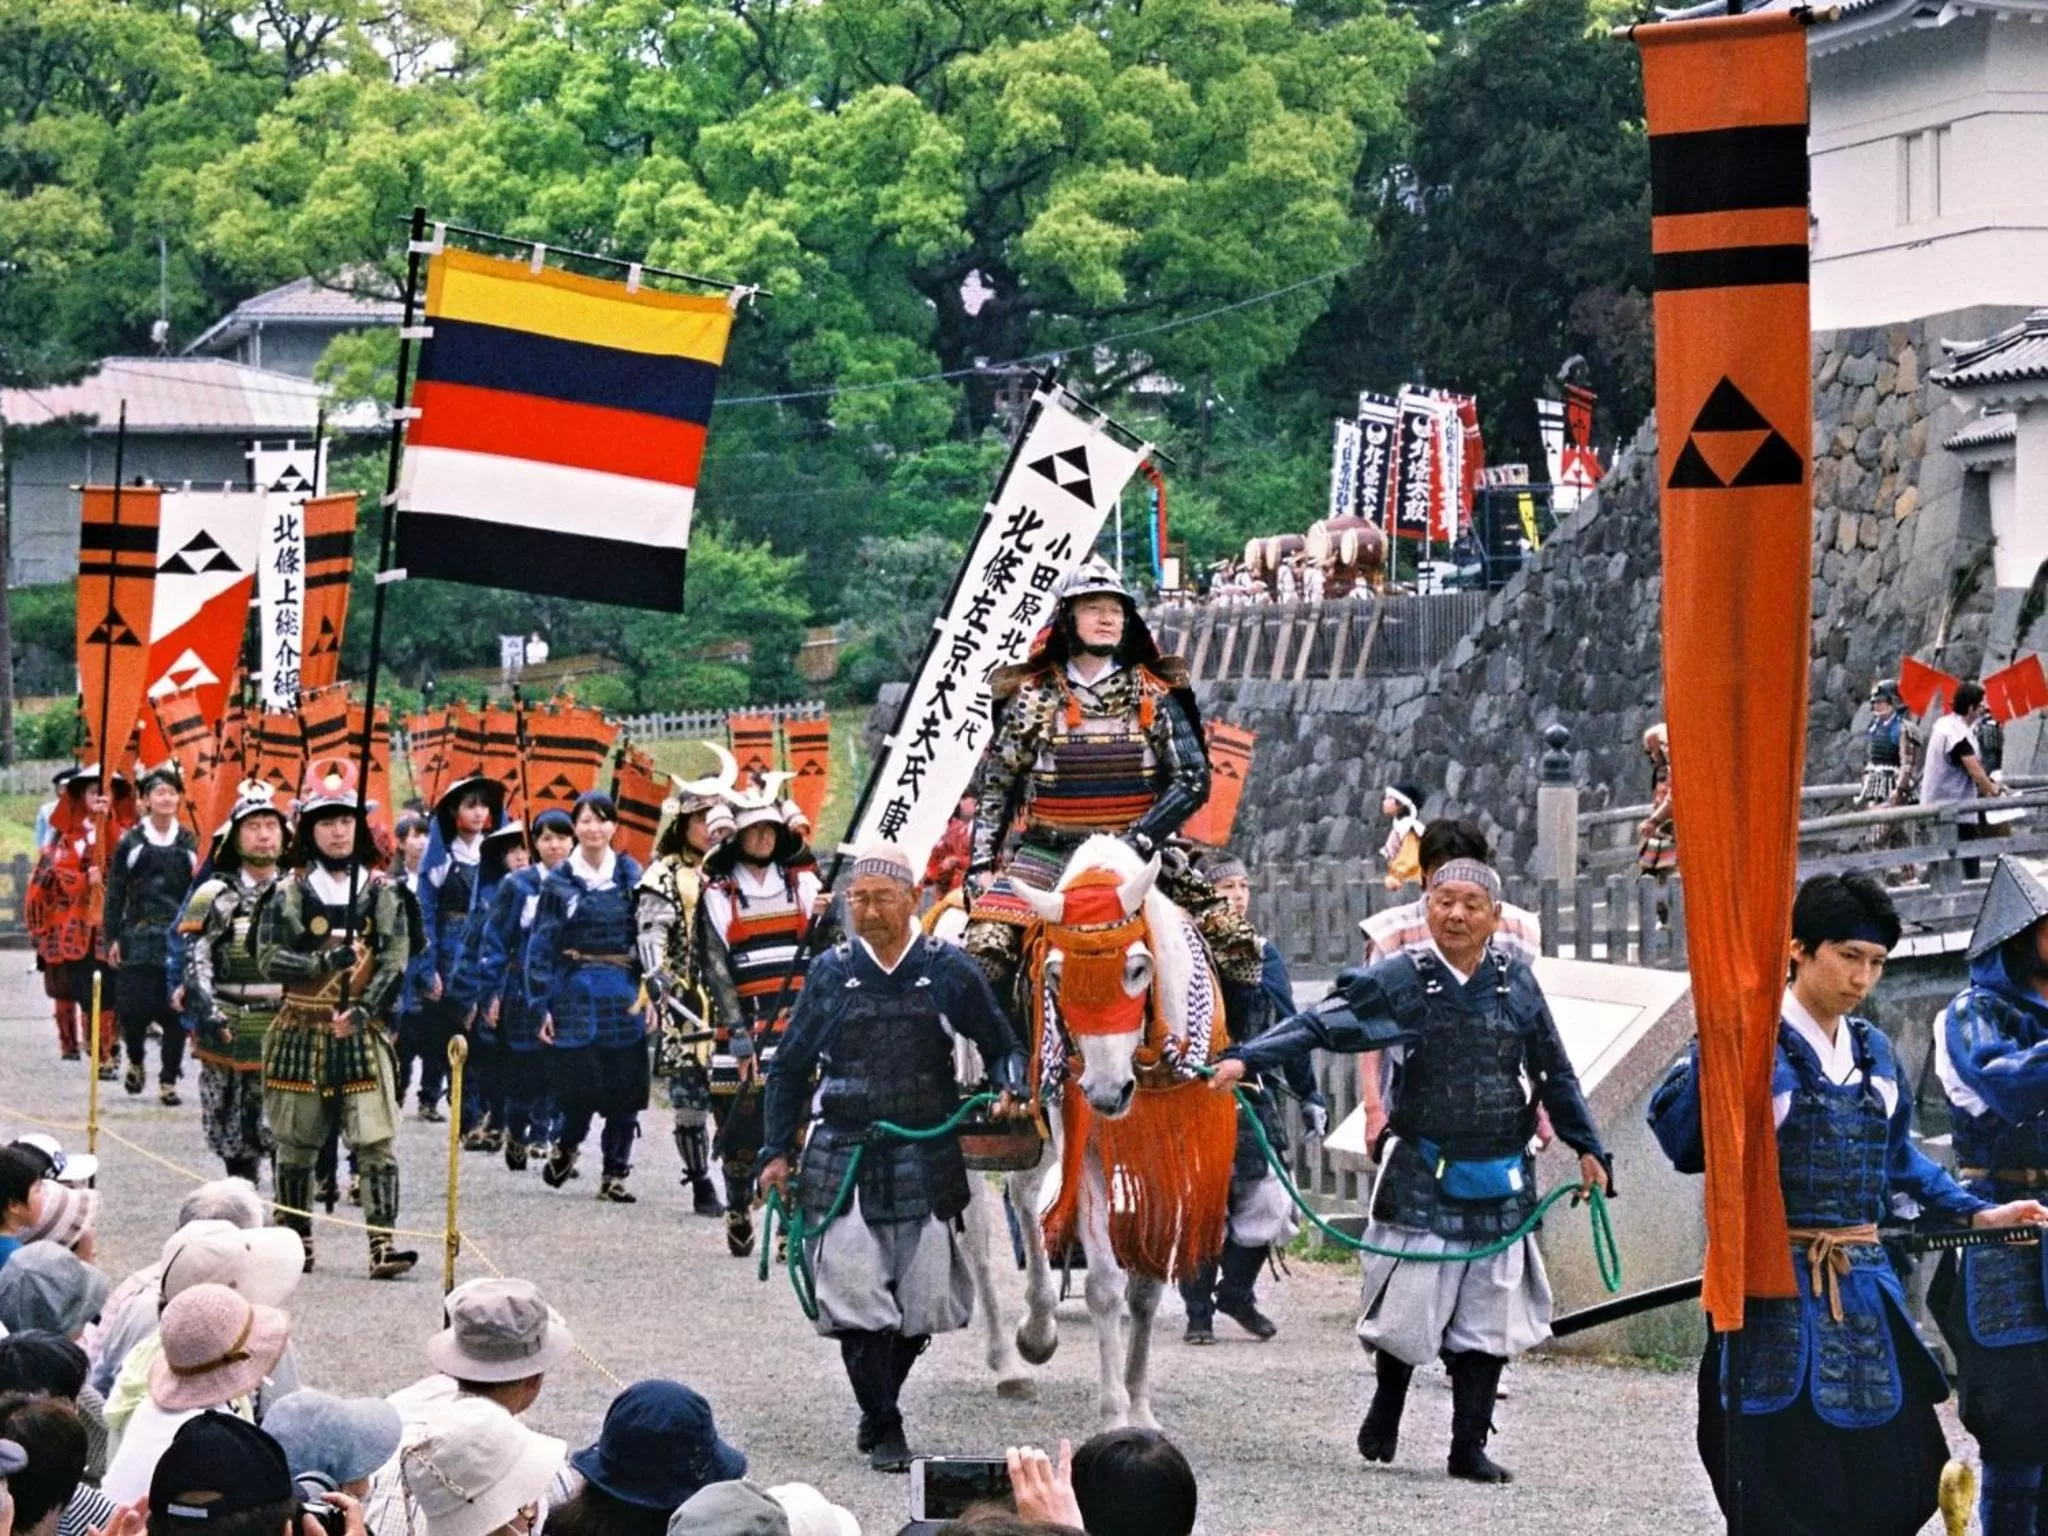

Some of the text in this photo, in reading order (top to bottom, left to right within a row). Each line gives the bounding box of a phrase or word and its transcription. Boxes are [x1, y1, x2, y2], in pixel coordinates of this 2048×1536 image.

[1402, 437, 1430, 521] 北條太鼓
[877, 504, 1045, 843] 北條左京大夫氏康
